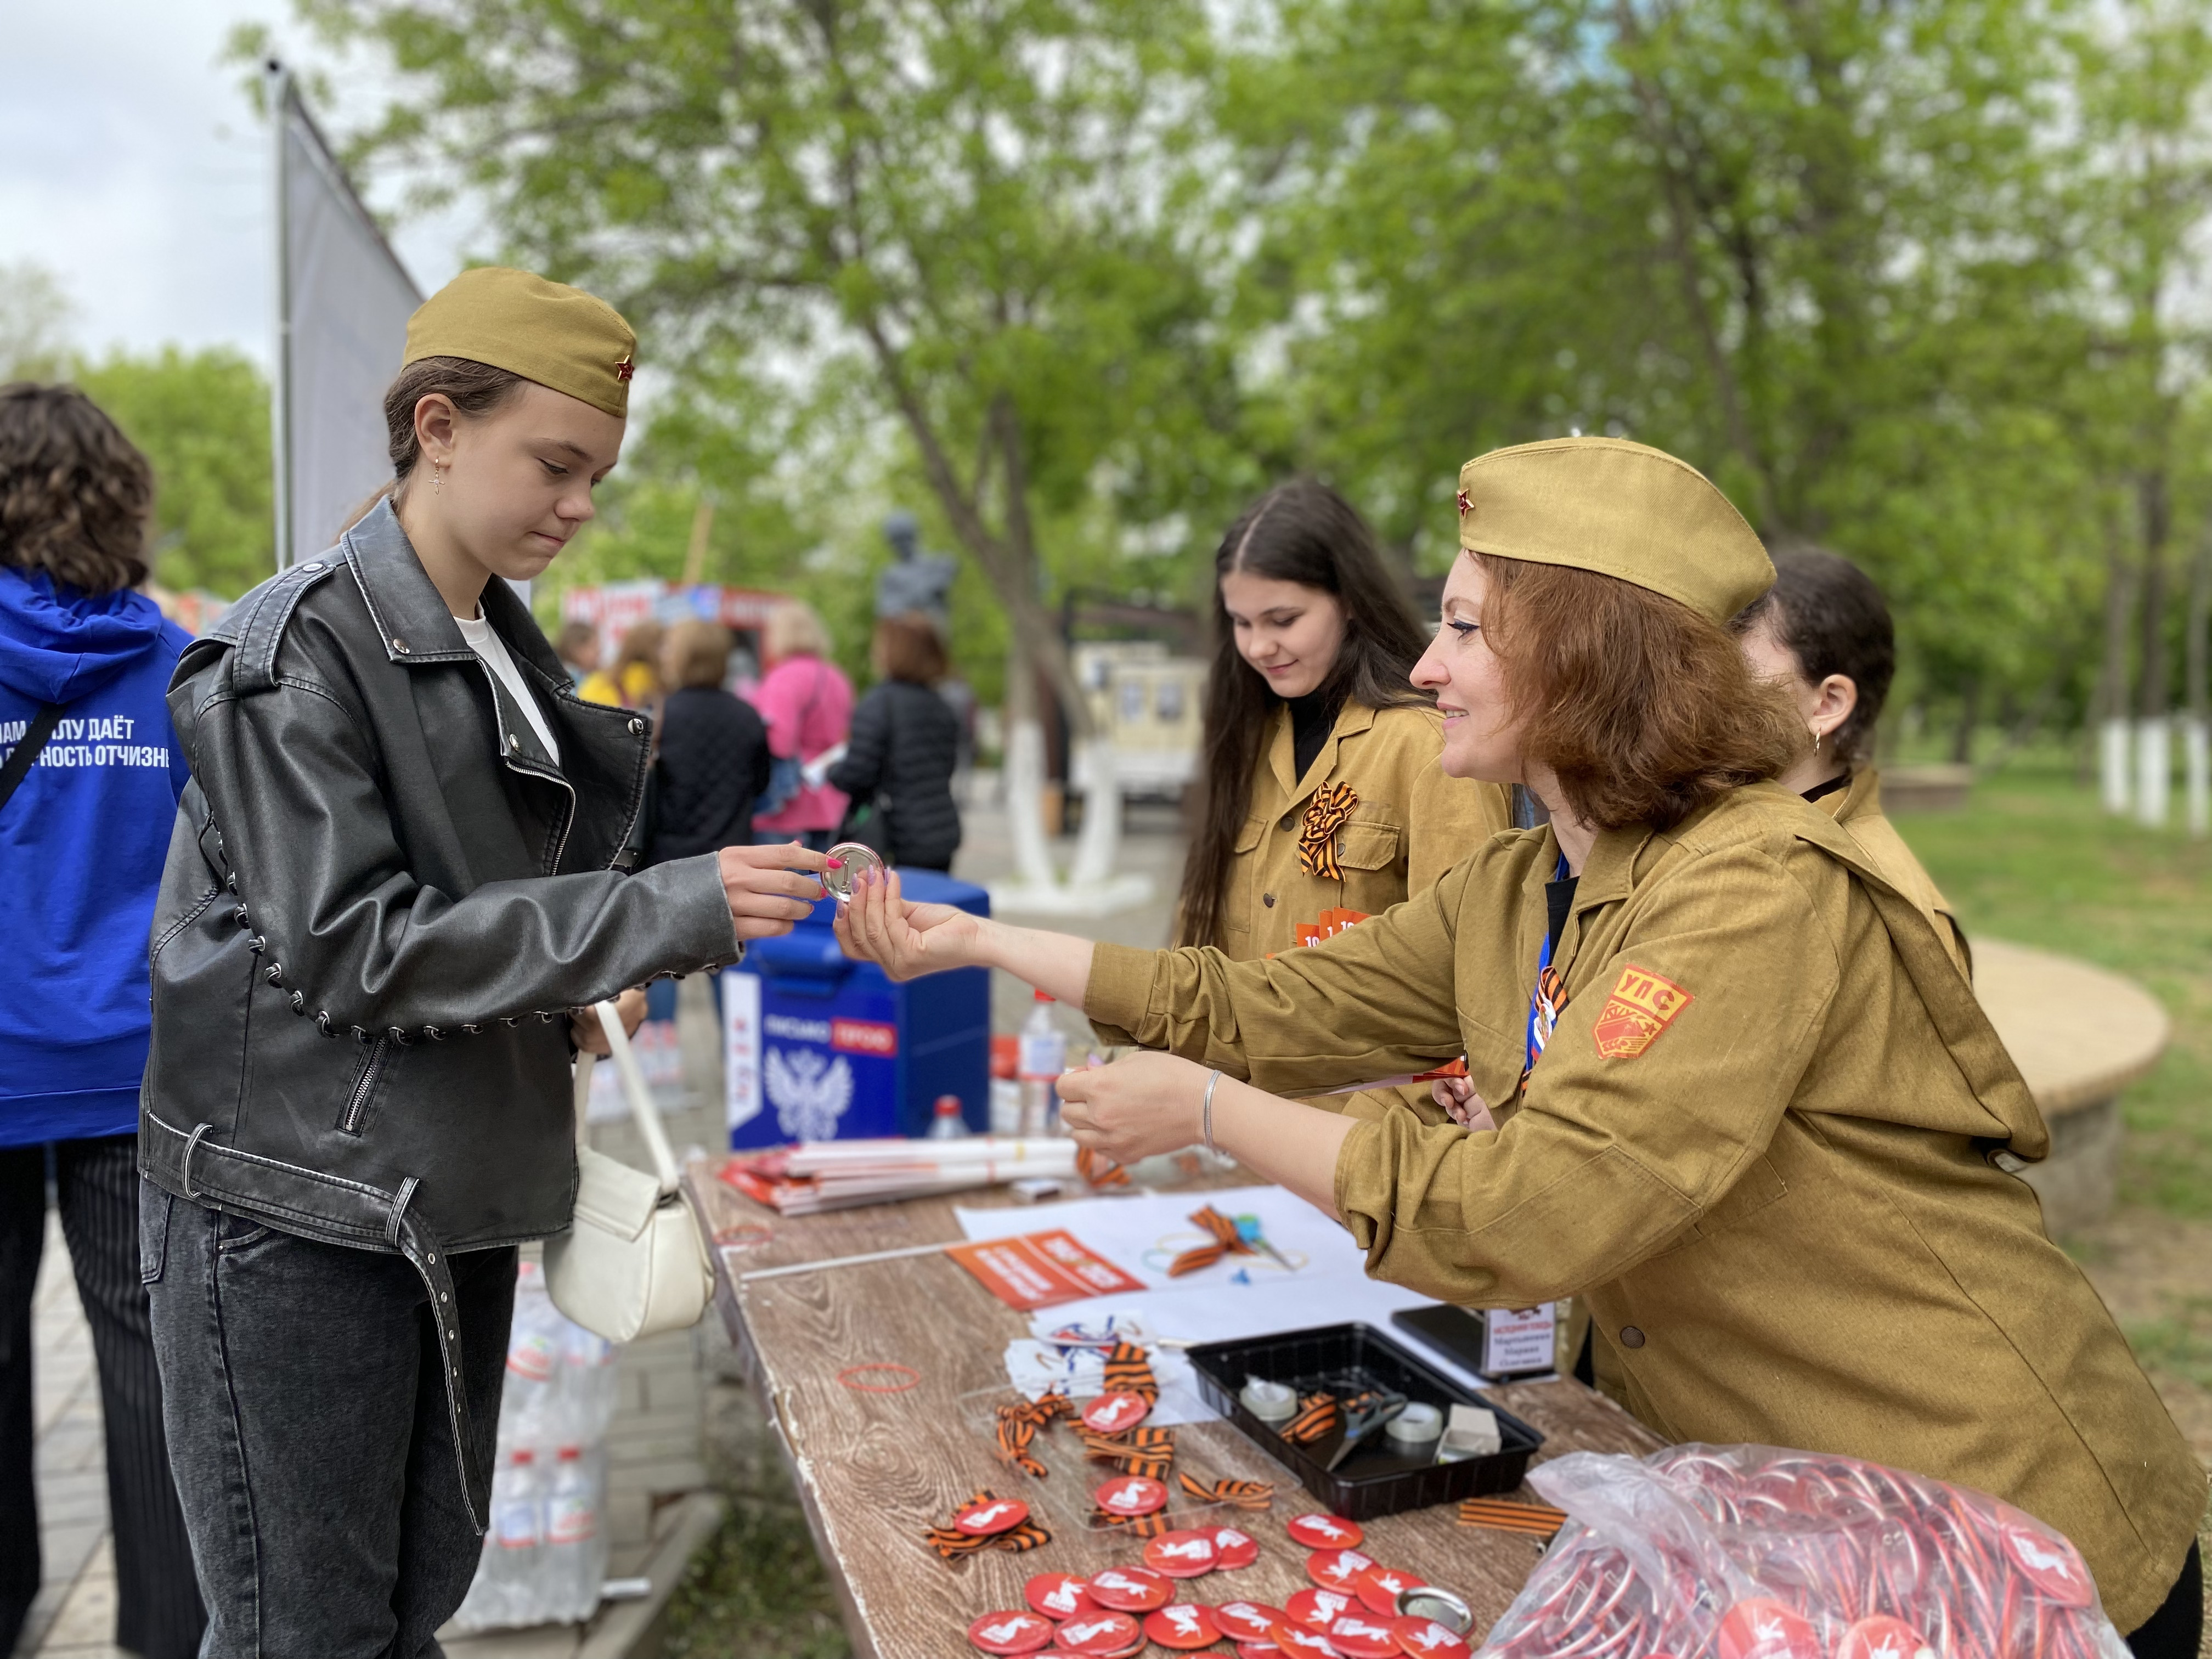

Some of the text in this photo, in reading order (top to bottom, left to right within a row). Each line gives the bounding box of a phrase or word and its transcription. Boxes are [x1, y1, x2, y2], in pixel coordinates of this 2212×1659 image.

[0, 720, 26, 744] АМ
[88, 715, 134, 741] ДАЁТ
[1620, 974, 1675, 1011] УПС
